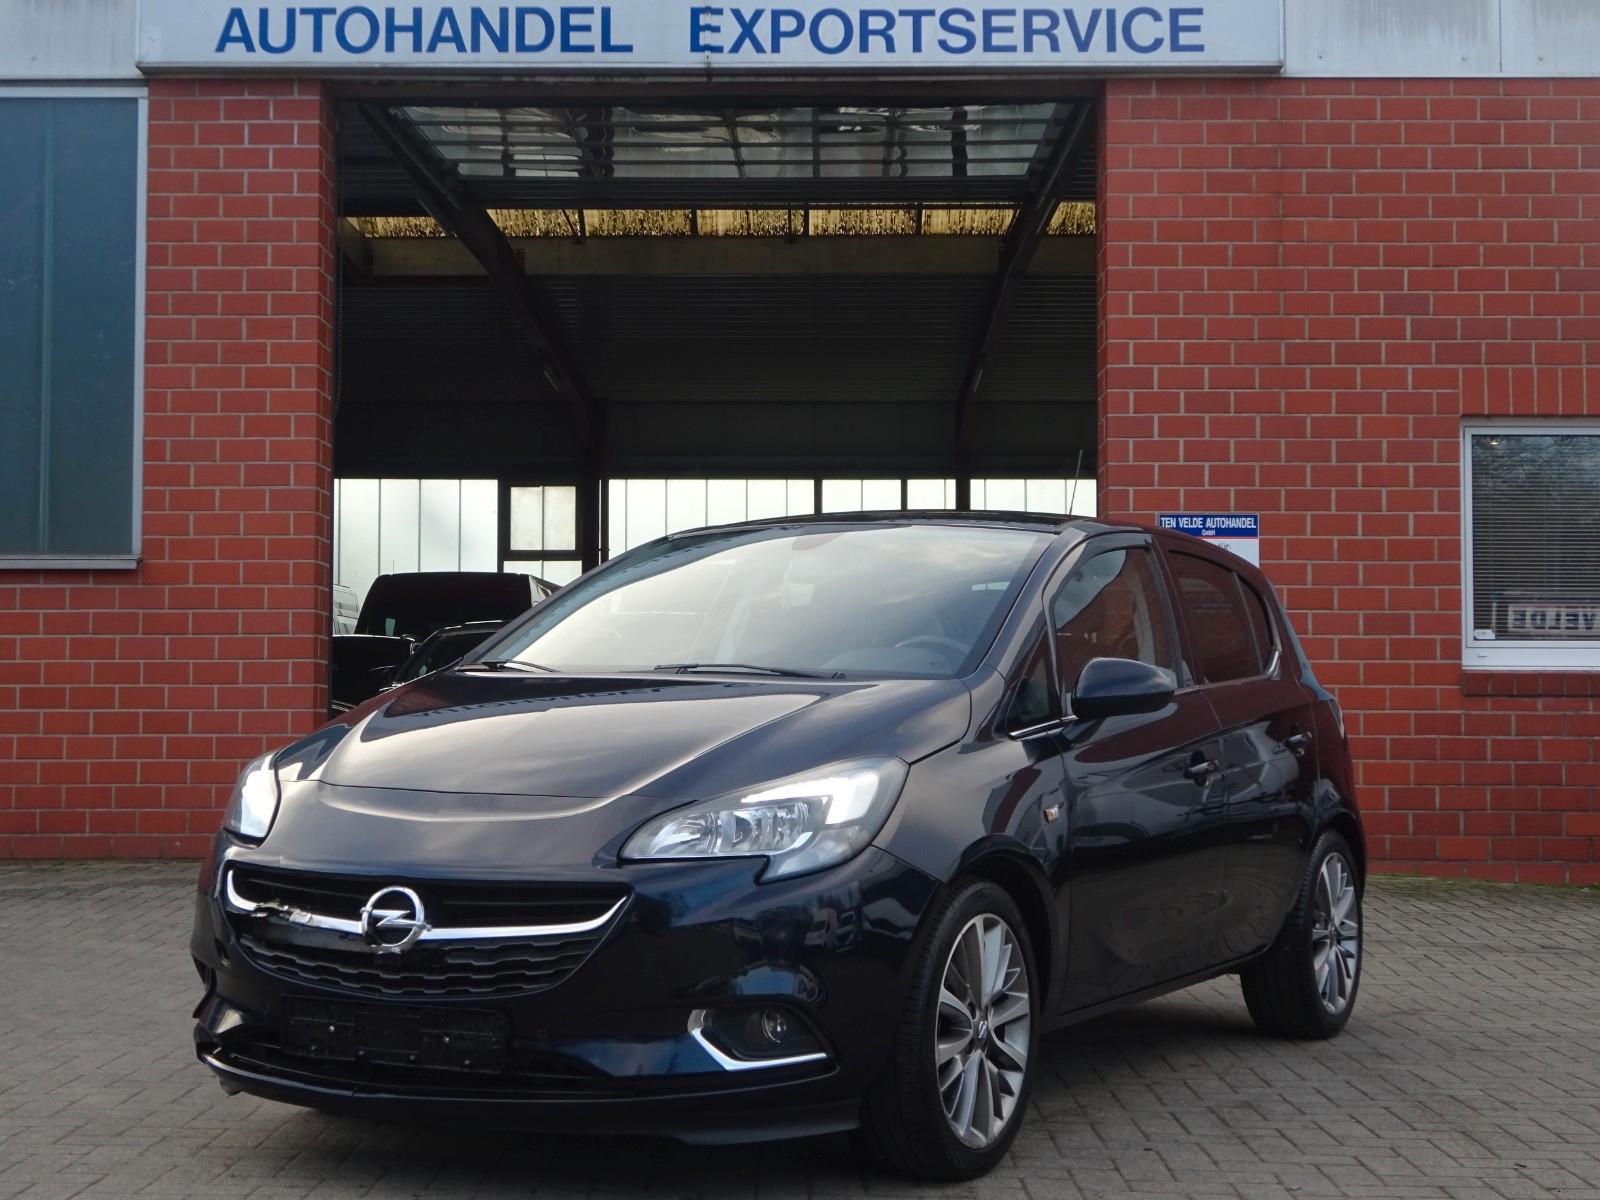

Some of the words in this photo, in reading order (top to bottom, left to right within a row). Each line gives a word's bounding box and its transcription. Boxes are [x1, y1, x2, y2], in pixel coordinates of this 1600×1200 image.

[215, 6, 633, 54] AUTOHANDEL
[690, 6, 1204, 54] EXPORTSERVICE
[1160, 517, 1176, 528] TEN
[1179, 517, 1204, 528] VELDE
[1206, 517, 1257, 528] AUTOHANDEL
